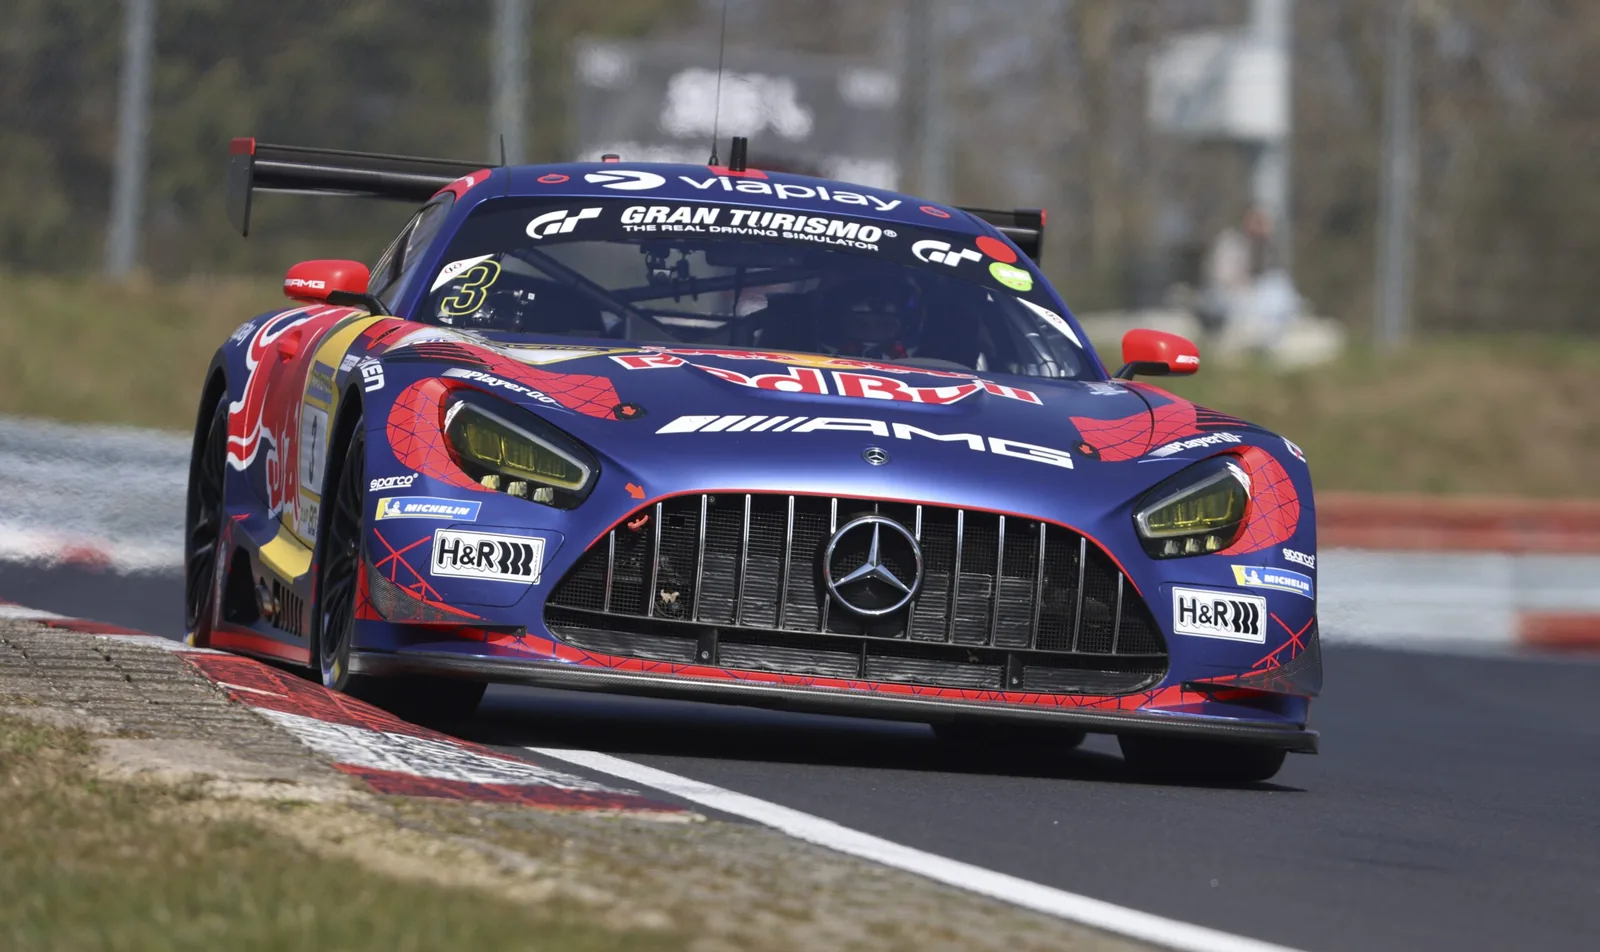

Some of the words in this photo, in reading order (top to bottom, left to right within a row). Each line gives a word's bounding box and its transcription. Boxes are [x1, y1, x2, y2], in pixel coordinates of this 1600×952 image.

[678, 176, 902, 211] viaplay
[620, 206, 720, 225] GRAN
[622, 225, 657, 233] THE
[660, 224, 706, 233] REAL
[709, 225, 779, 238] DRIVING
[782, 231, 879, 252] SIMULATOR
[290, 278, 325, 289] AMG
[441, 259, 501, 316] 3
[608, 352, 829, 396] Red
[831, 369, 1044, 405] Bull
[792, 416, 1075, 470] AMG
[370, 475, 415, 491] sparco
[404, 503, 470, 516] MICHELIN
[437, 538, 495, 569] H&R
[1282, 548, 1314, 567] sparco
[1264, 574, 1310, 591] MICHELIN
[1179, 596, 1230, 628] H&R
